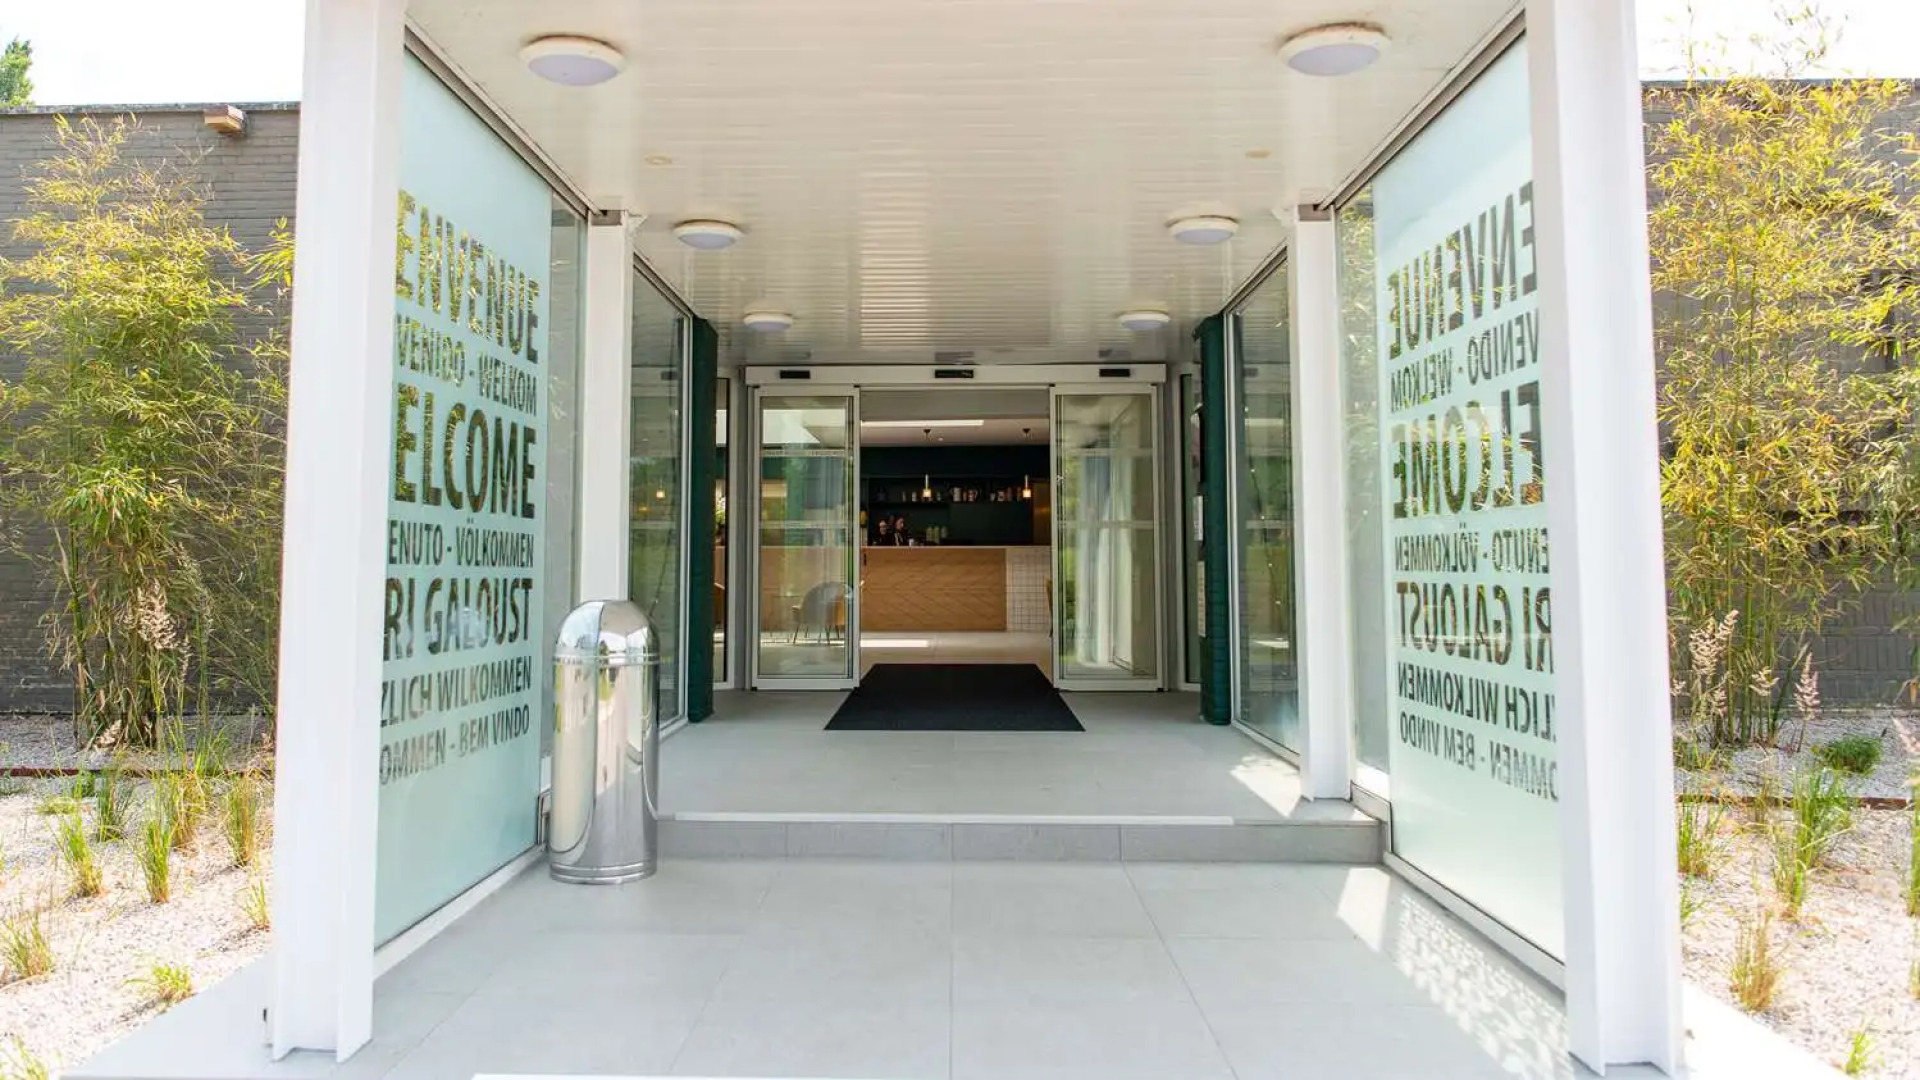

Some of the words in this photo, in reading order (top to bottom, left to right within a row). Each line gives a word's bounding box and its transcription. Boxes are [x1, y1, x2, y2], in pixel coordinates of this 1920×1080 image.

[394, 189, 540, 364] ENVENUE
[396, 313, 466, 388] VENIDO
[478, 352, 538, 417] WELKOM
[394, 382, 537, 519] ELCOME
[388, 520, 443, 566] ENUTO
[456, 517, 534, 568] VÖLKOMMEN
[383, 578, 416, 662] RI
[424, 577, 534, 655] GALOUST
[438, 655, 532, 712] WILKOMMEN
[459, 713, 489, 758] BEM
[493, 704, 530, 746] VINDO
